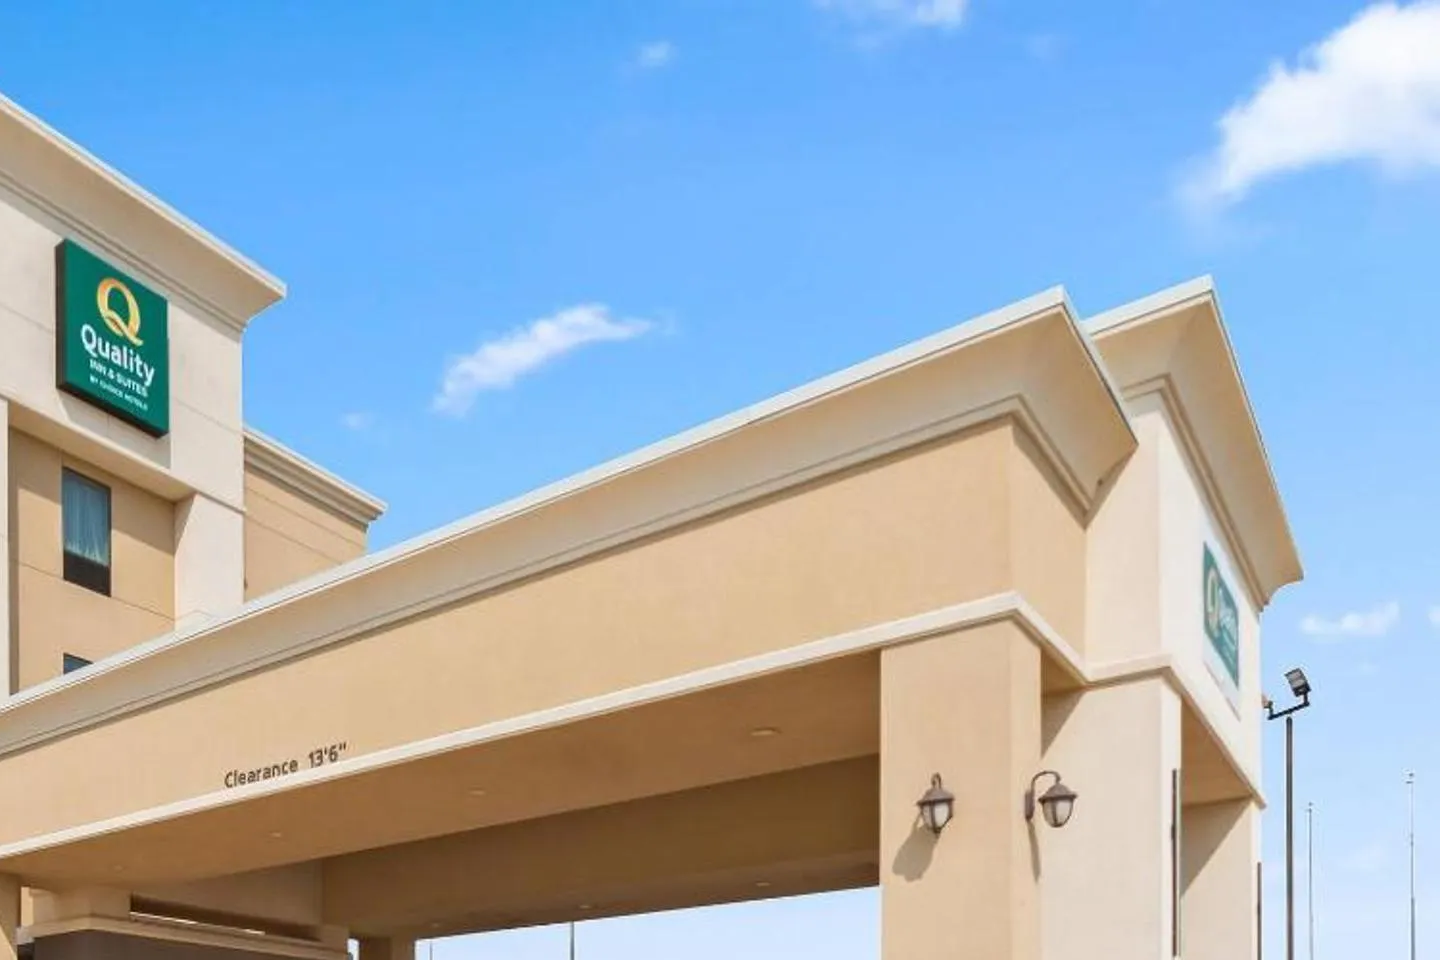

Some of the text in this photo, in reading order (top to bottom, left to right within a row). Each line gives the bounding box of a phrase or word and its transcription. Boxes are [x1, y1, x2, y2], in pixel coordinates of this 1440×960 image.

[97, 277, 144, 346] Q
[81, 324, 155, 386] Quality
[224, 741, 347, 788] Clearance 13'6"
